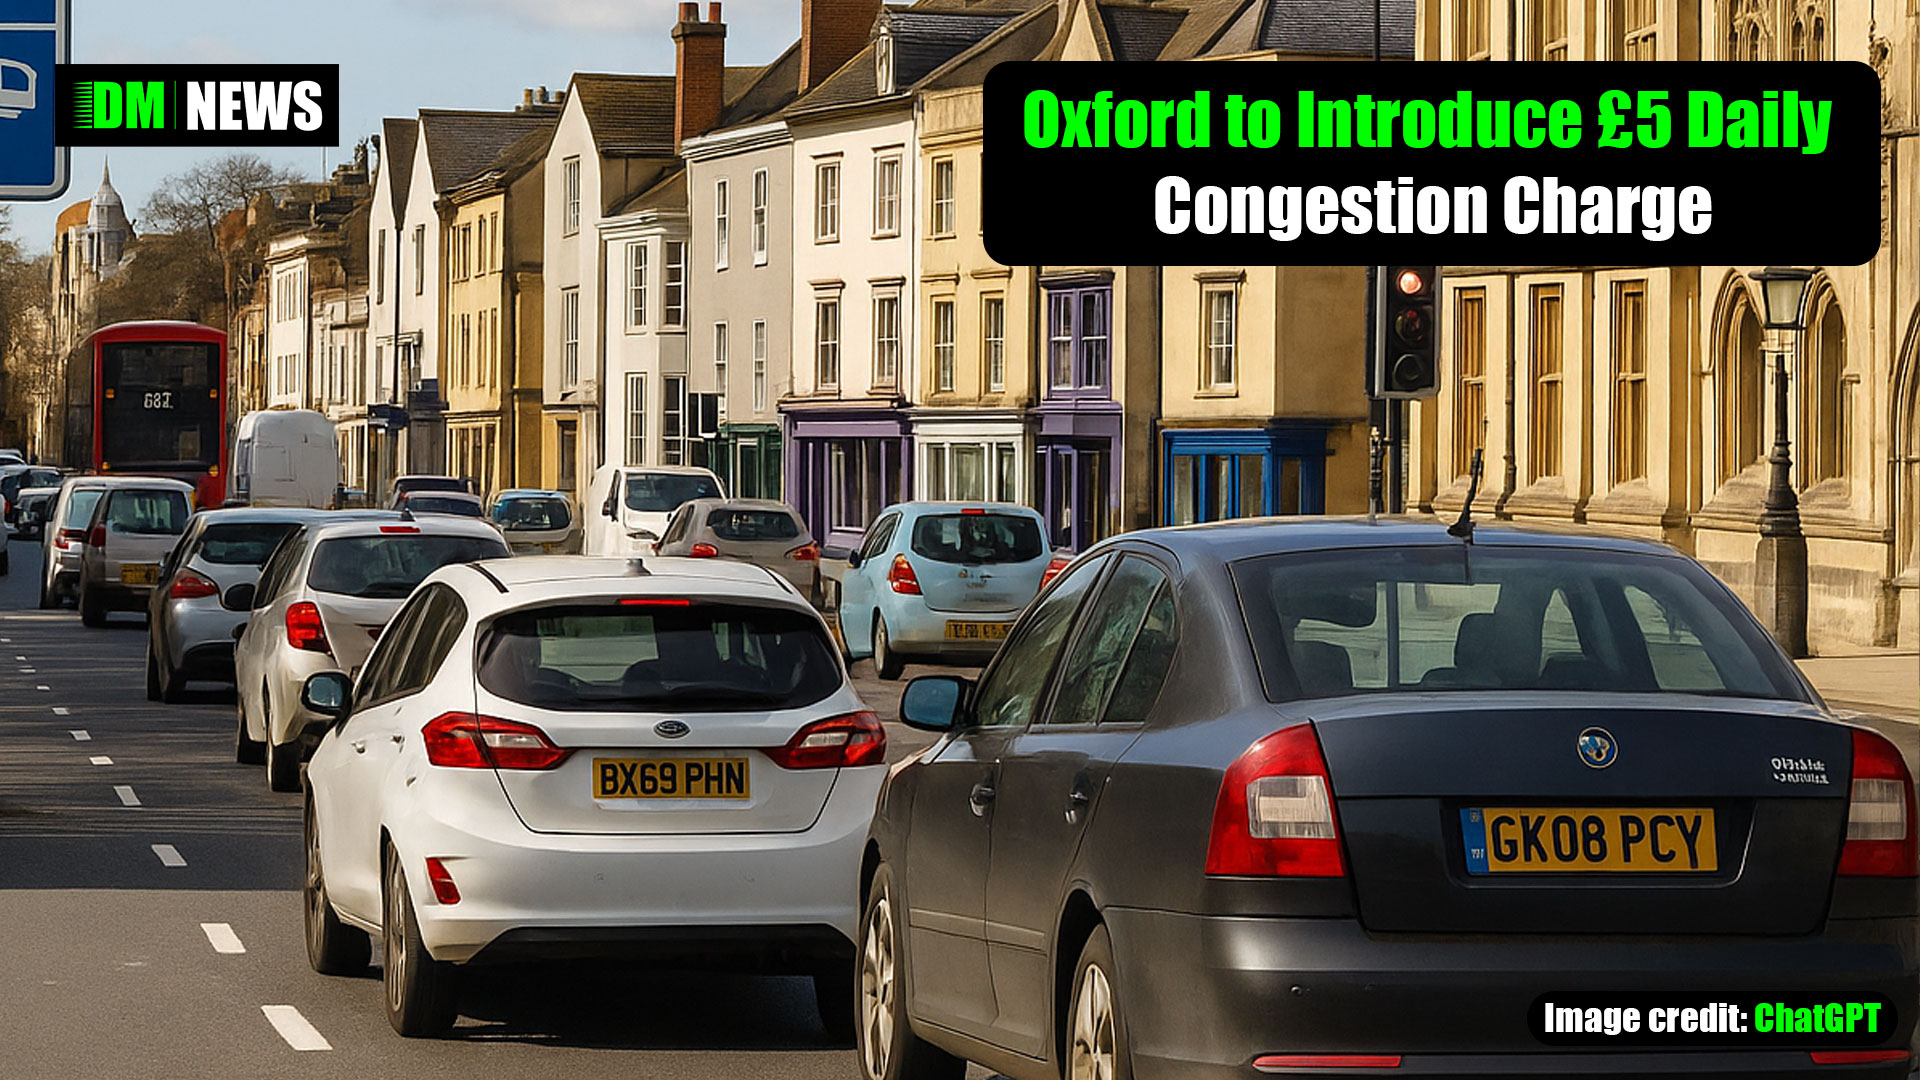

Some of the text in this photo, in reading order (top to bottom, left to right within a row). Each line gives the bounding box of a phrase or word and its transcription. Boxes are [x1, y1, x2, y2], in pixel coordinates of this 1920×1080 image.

[600, 762, 745, 796] BX69 PHN
[1491, 815, 1702, 869] GK08 PCY
